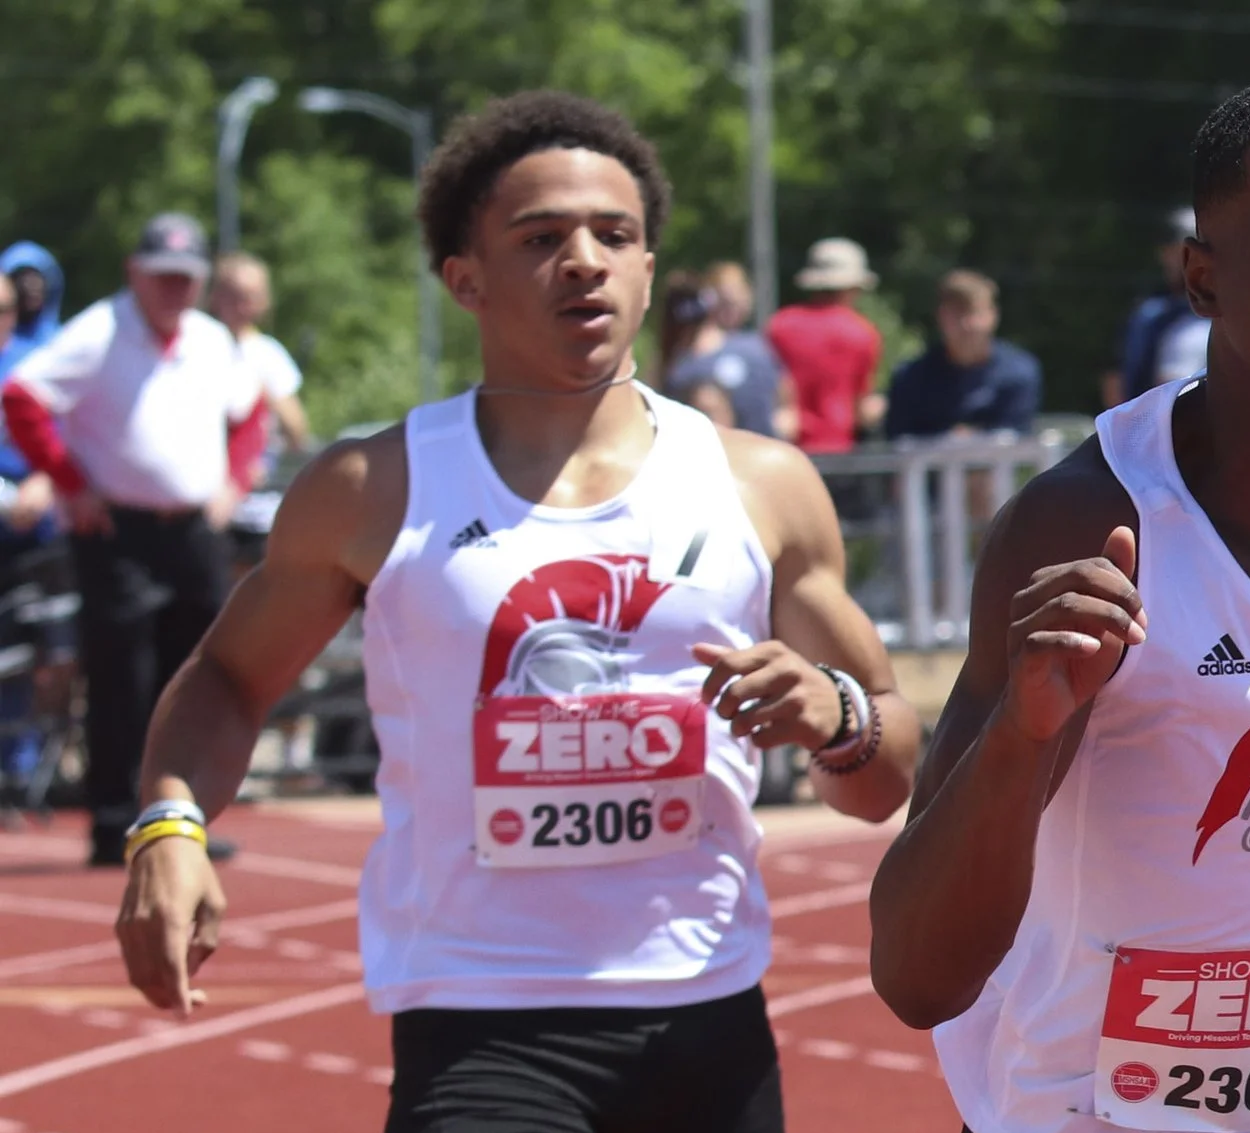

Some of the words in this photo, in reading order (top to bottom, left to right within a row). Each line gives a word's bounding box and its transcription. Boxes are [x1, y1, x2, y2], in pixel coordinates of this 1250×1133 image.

[496, 714, 682, 773] ZERO
[531, 798, 652, 847] 2306
[1168, 1033, 1202, 1043] Driving
[1202, 1033, 1240, 1042] Missouri
